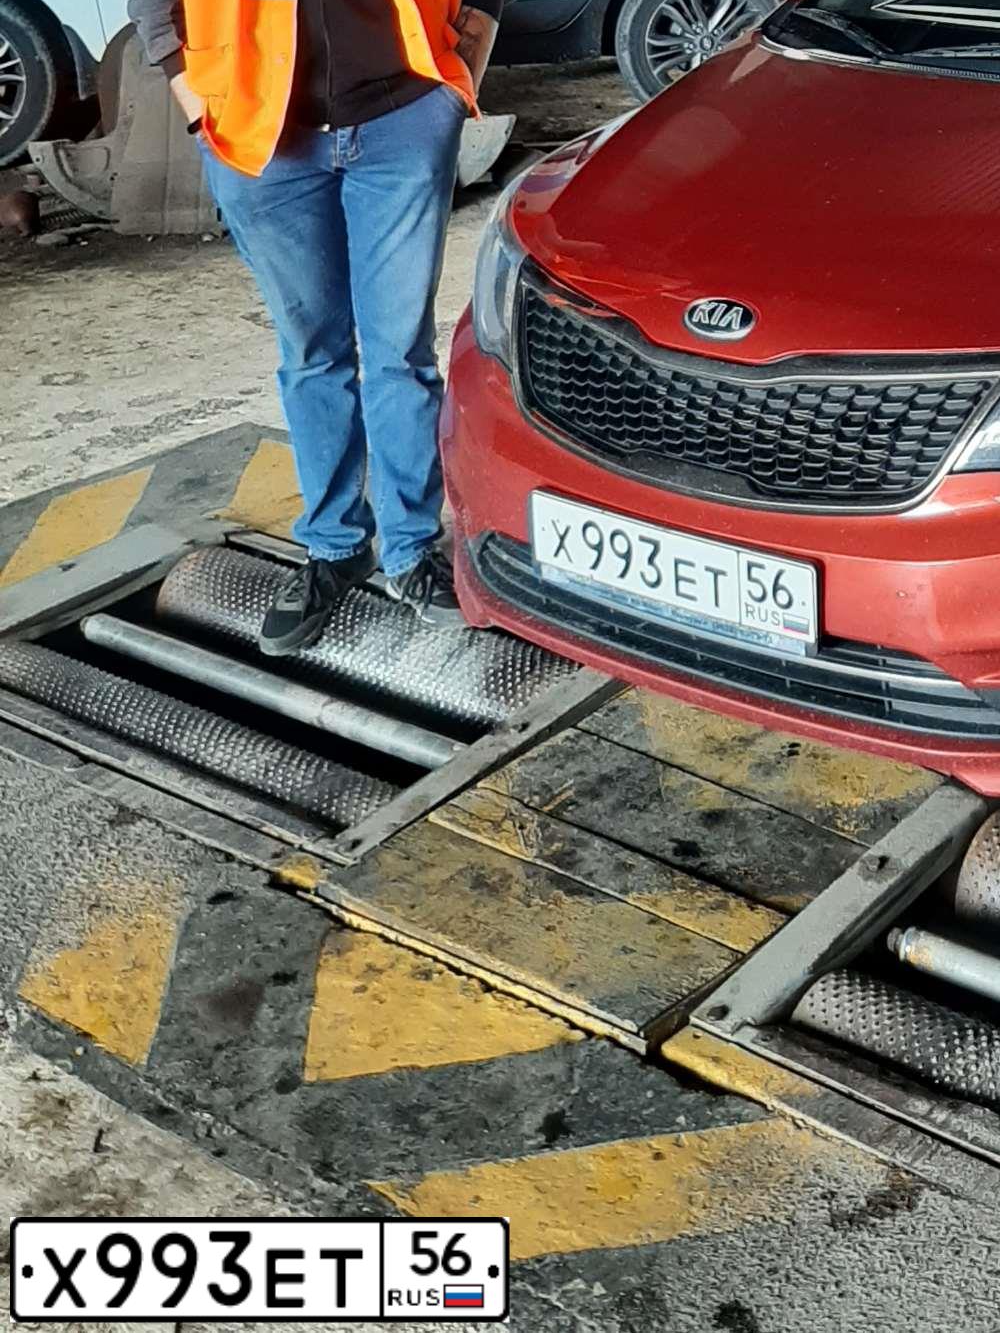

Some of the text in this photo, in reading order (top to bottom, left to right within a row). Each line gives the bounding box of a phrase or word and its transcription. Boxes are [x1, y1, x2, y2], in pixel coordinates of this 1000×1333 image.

[692, 301, 744, 330] KIA
[551, 518, 728, 608] Х993ЕТ
[746, 561, 794, 610] 56
[745, 602, 781, 626] RUS
